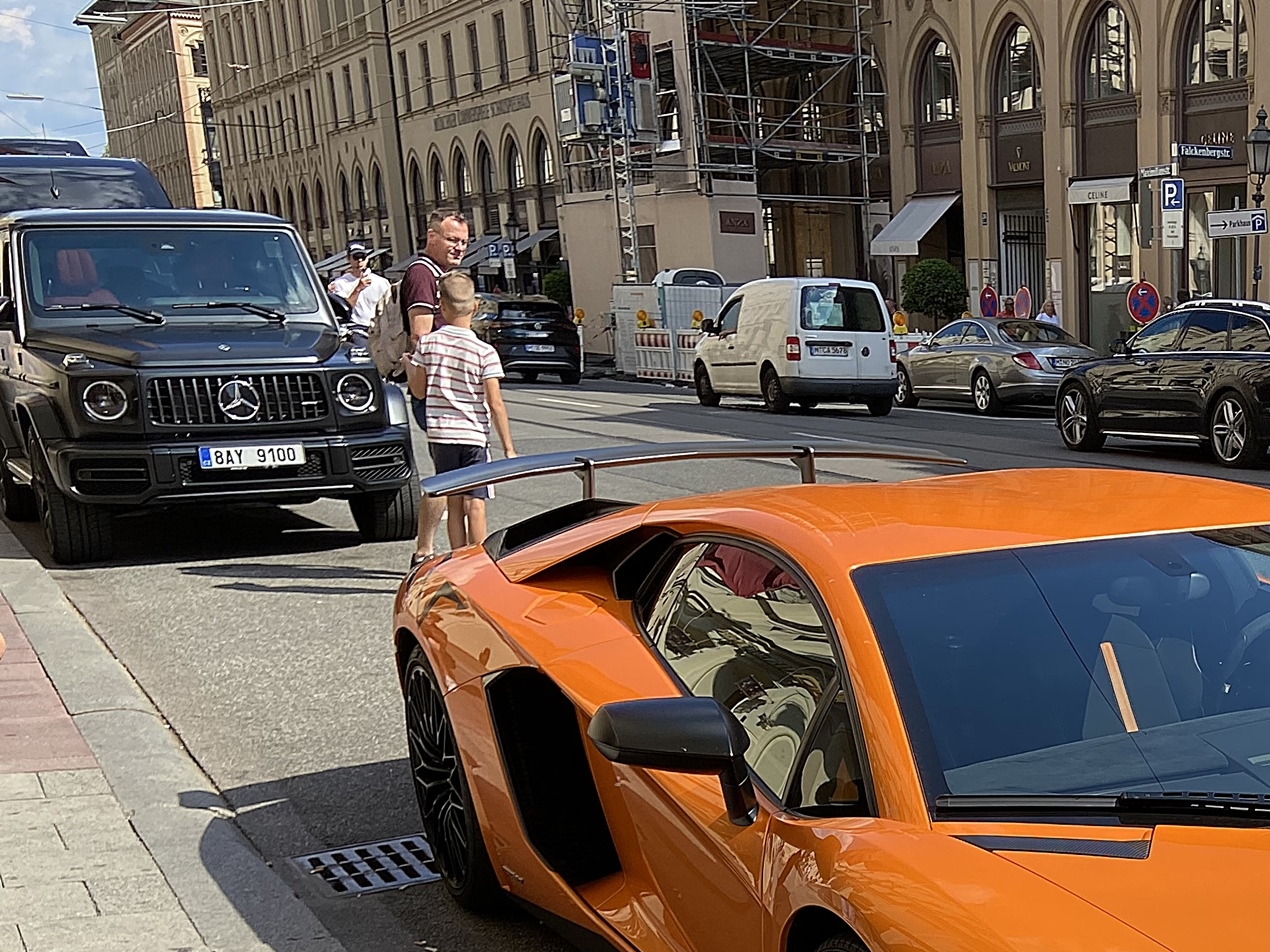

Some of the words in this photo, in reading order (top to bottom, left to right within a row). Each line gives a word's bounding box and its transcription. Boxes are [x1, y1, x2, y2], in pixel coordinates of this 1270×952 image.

[1087, 190, 1109, 200] CELINE
[1165, 183, 1177, 206] P
[214, 449, 243, 464] 8AY
[257, 447, 296, 463] 9100
